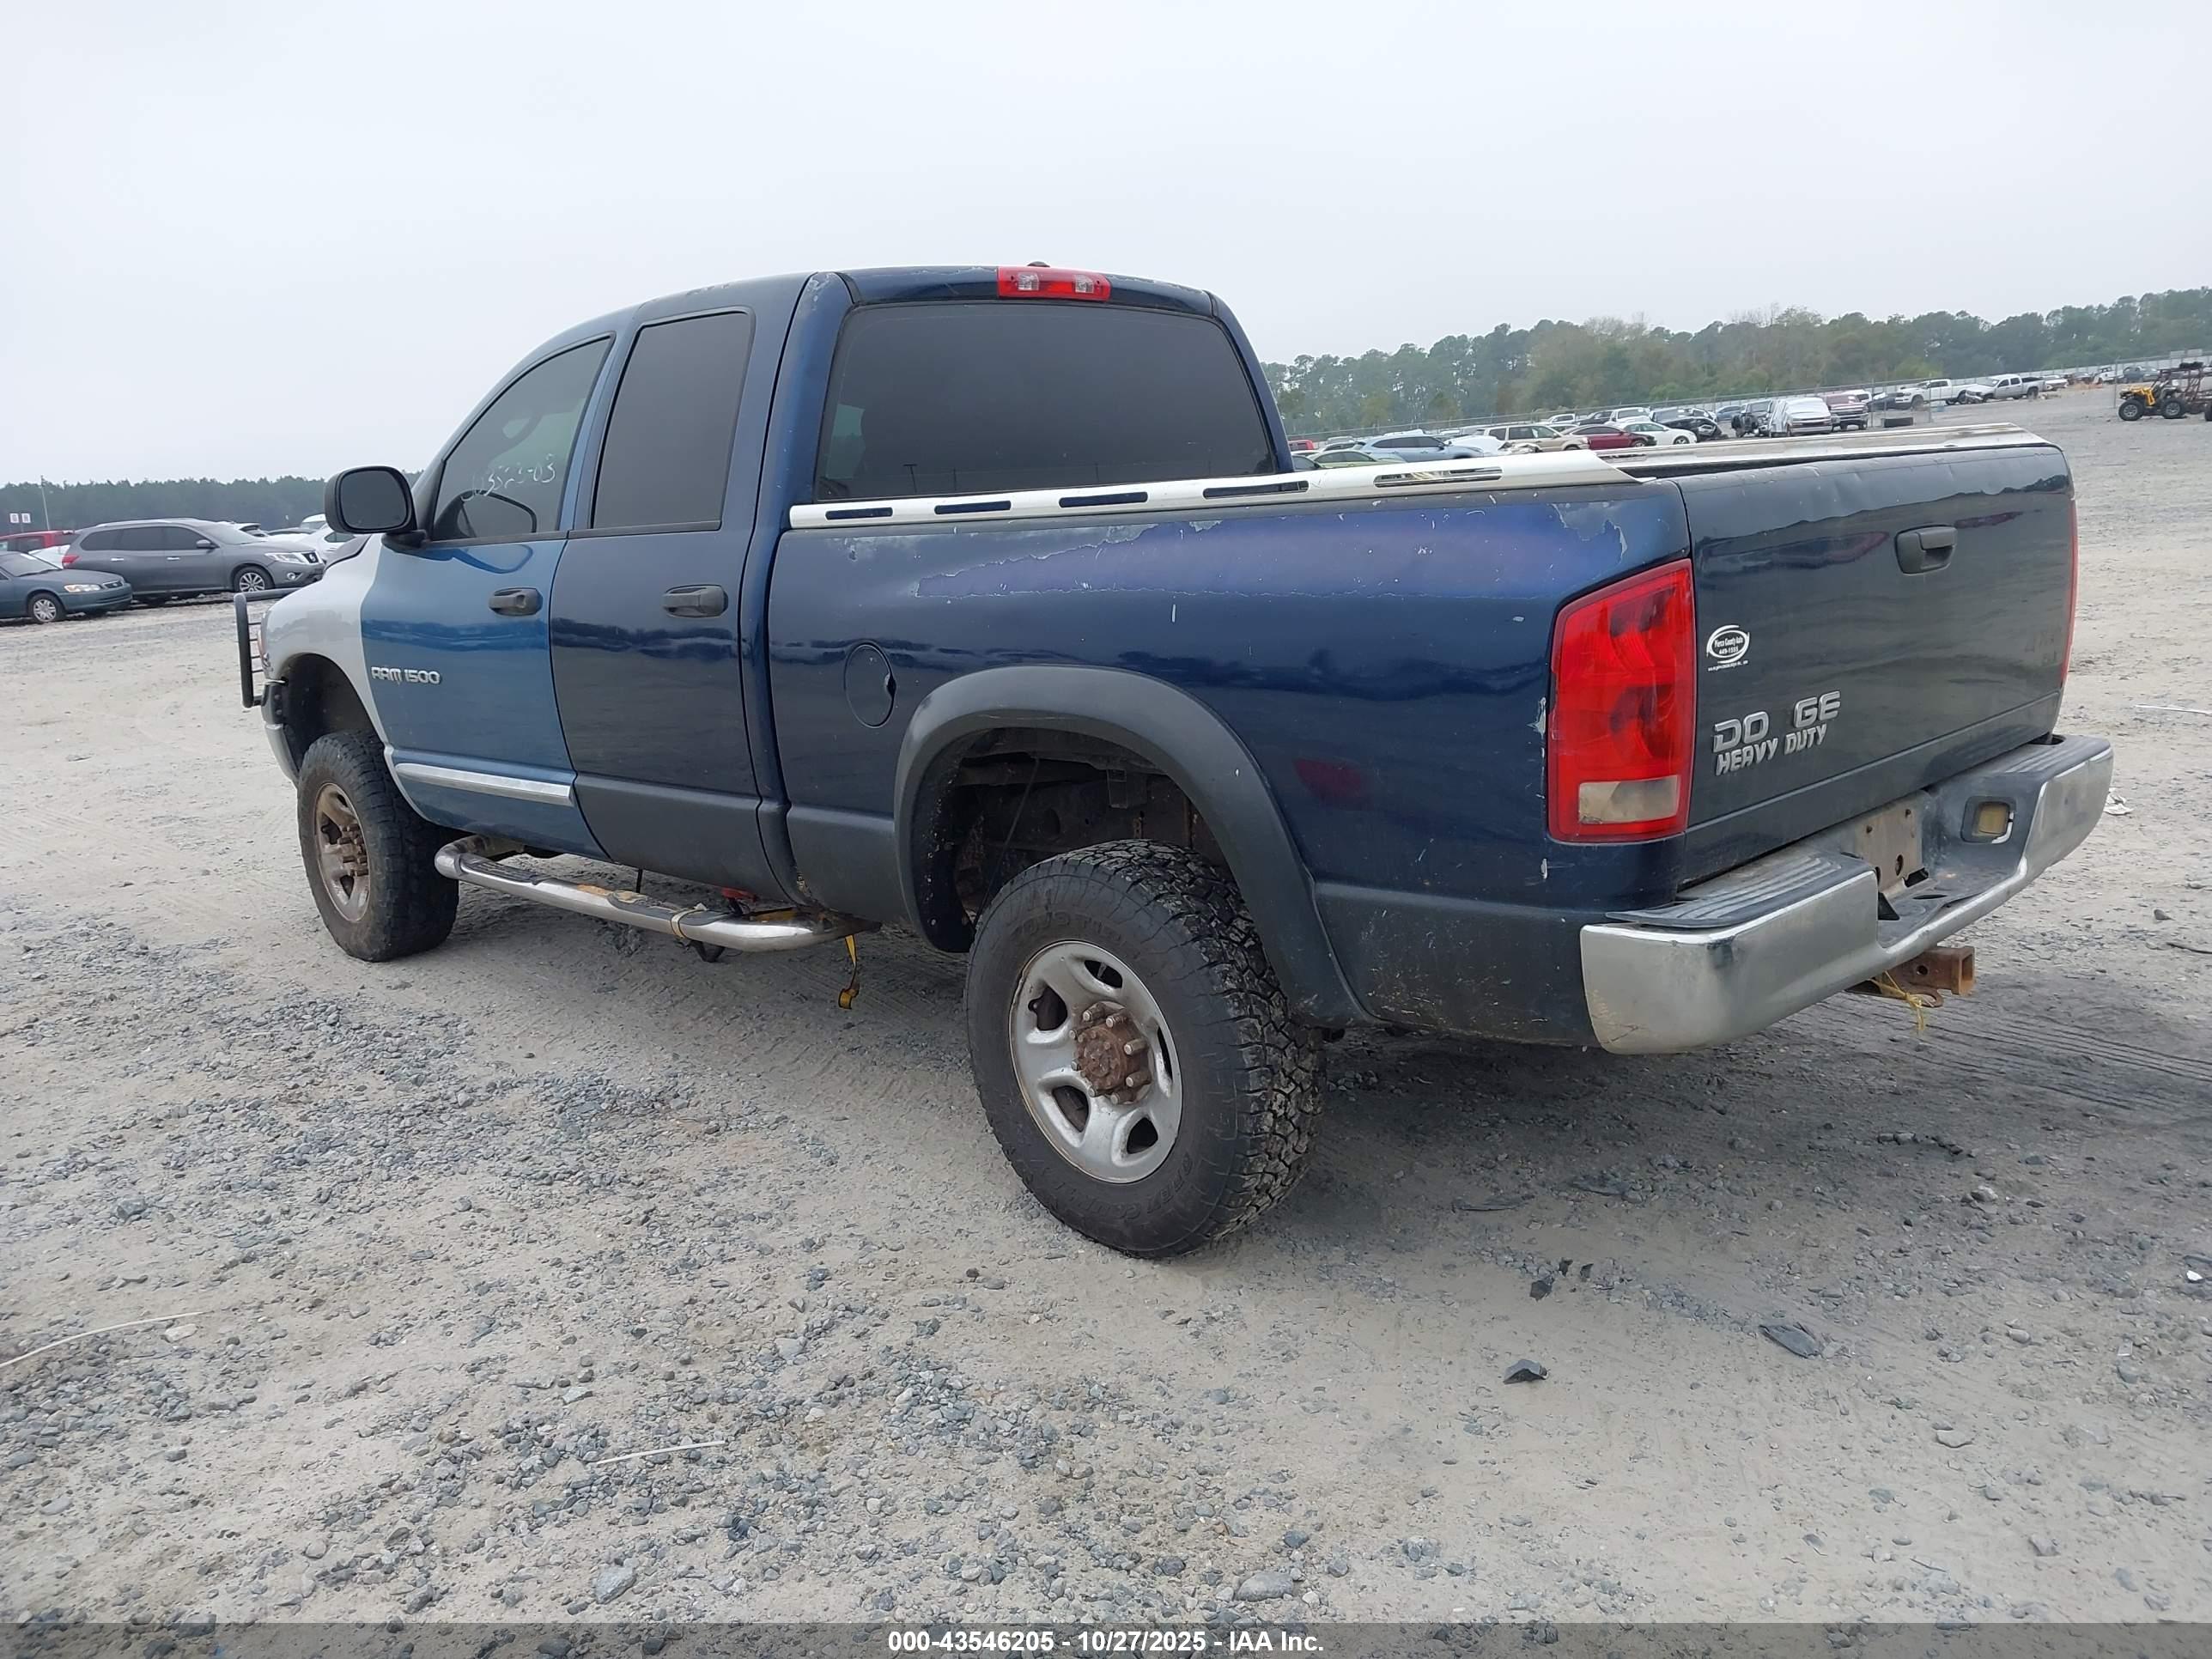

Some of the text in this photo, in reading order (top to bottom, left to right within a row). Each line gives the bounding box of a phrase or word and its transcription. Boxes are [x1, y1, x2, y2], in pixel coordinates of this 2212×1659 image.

[370, 665, 441, 684] RAM 1500
[1716, 723, 1827, 775] HEAVY DUTY
